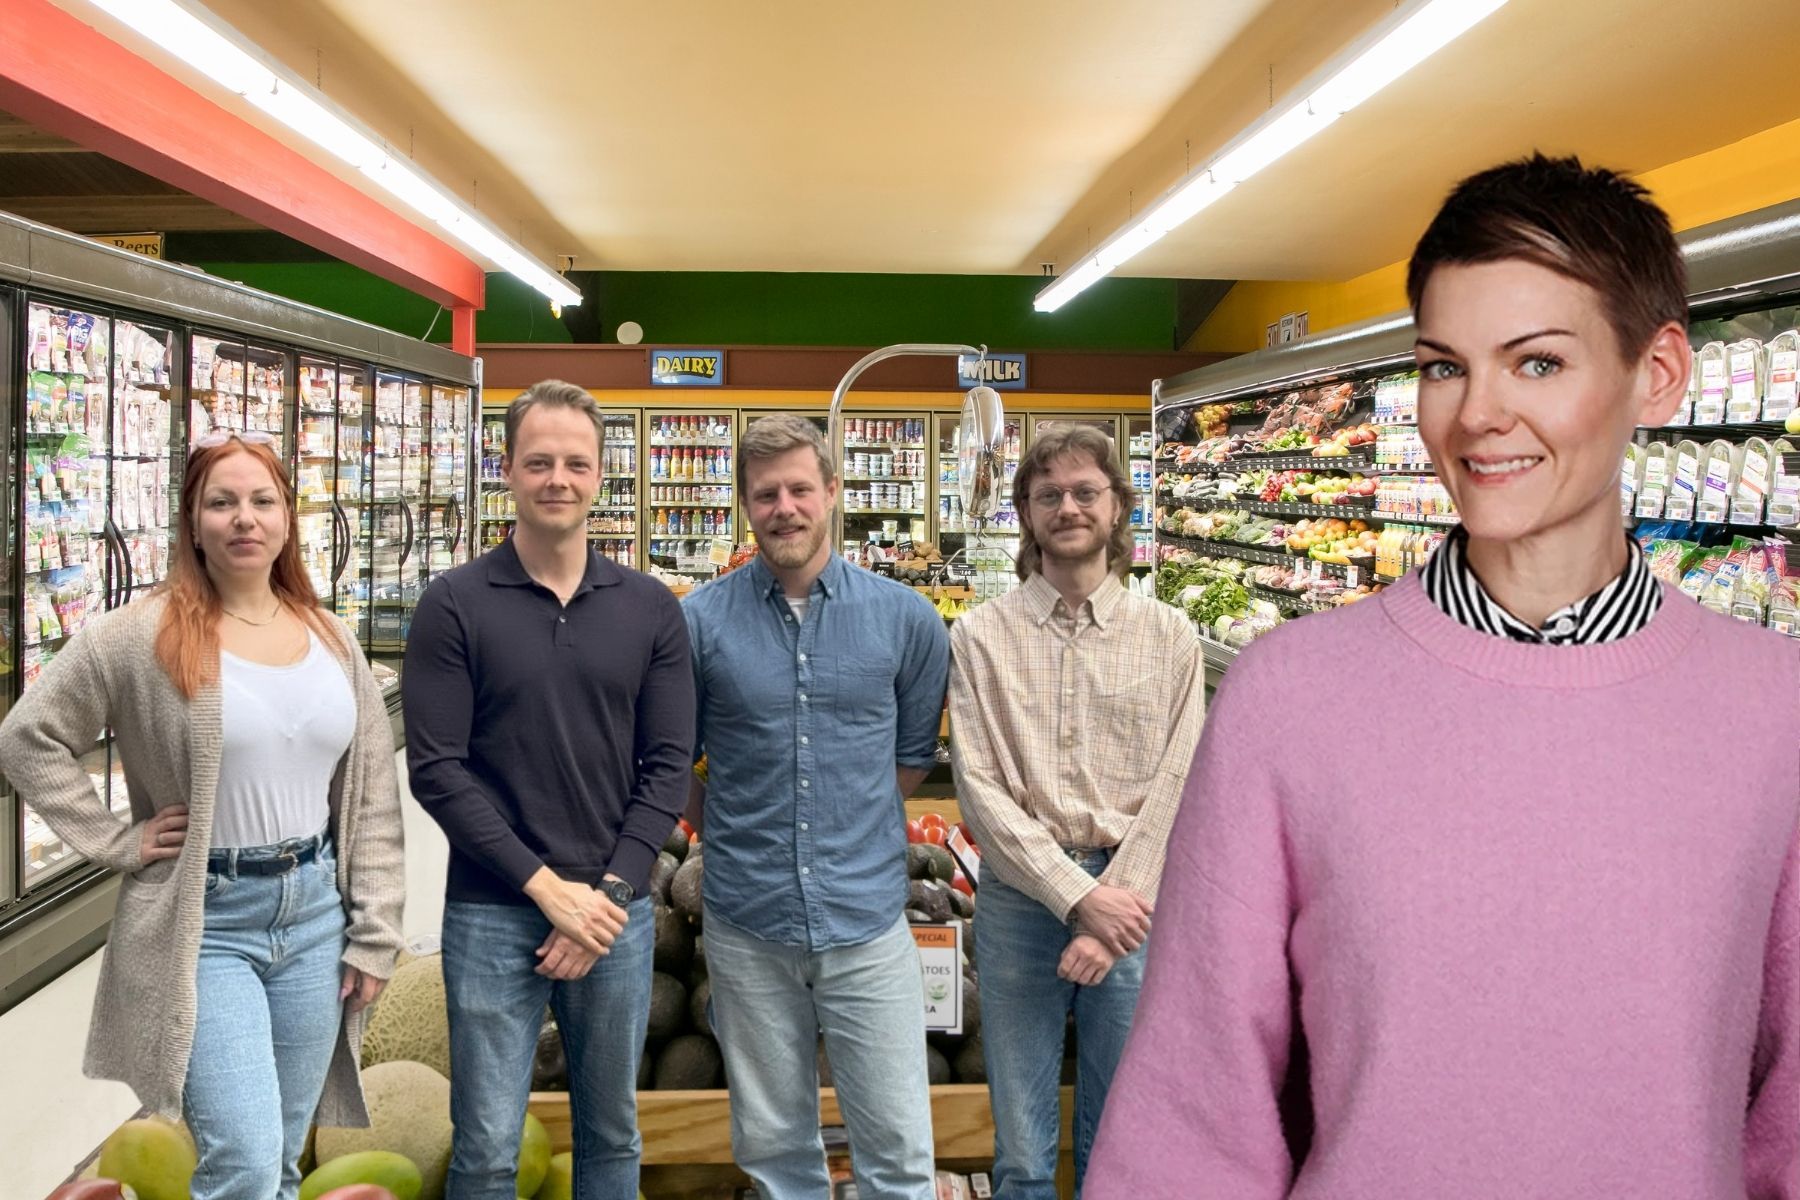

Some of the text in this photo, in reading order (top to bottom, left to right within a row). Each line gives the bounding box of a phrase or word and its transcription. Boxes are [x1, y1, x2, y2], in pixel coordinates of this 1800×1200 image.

[656, 357, 717, 377] DAIRY
[963, 359, 1021, 381] MILK
[921, 966, 951, 975] TOES
